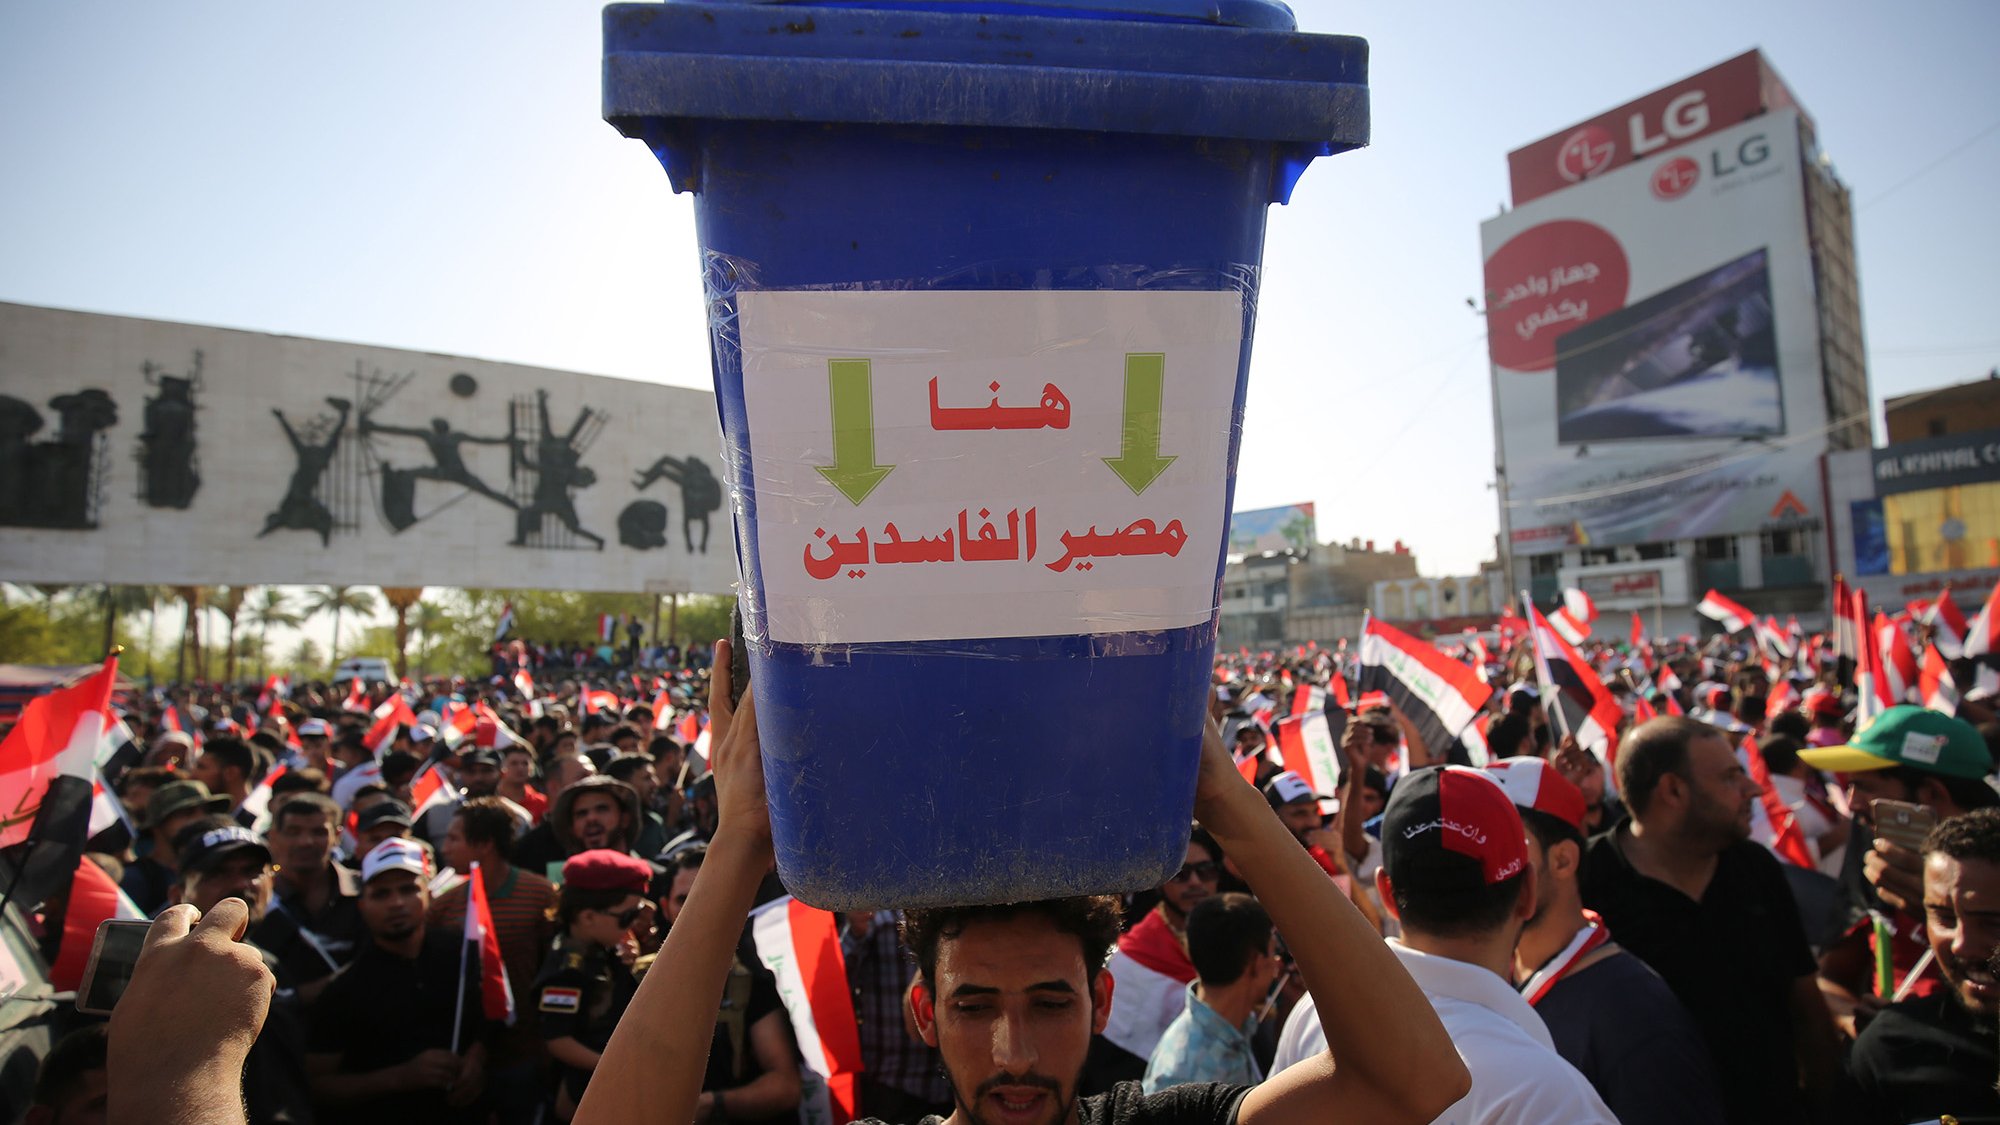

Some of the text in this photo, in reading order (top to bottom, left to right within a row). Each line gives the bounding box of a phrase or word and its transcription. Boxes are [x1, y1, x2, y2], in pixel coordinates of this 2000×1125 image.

[1628, 91, 1711, 155] LG
[1712, 133, 1770, 177] LG
[1549, 261, 1600, 295] جهاز
[1515, 297, 1588, 341] يكفي
[928, 375, 1072, 431] هنا
[803, 506, 1189, 580] مصير الفاسدين
